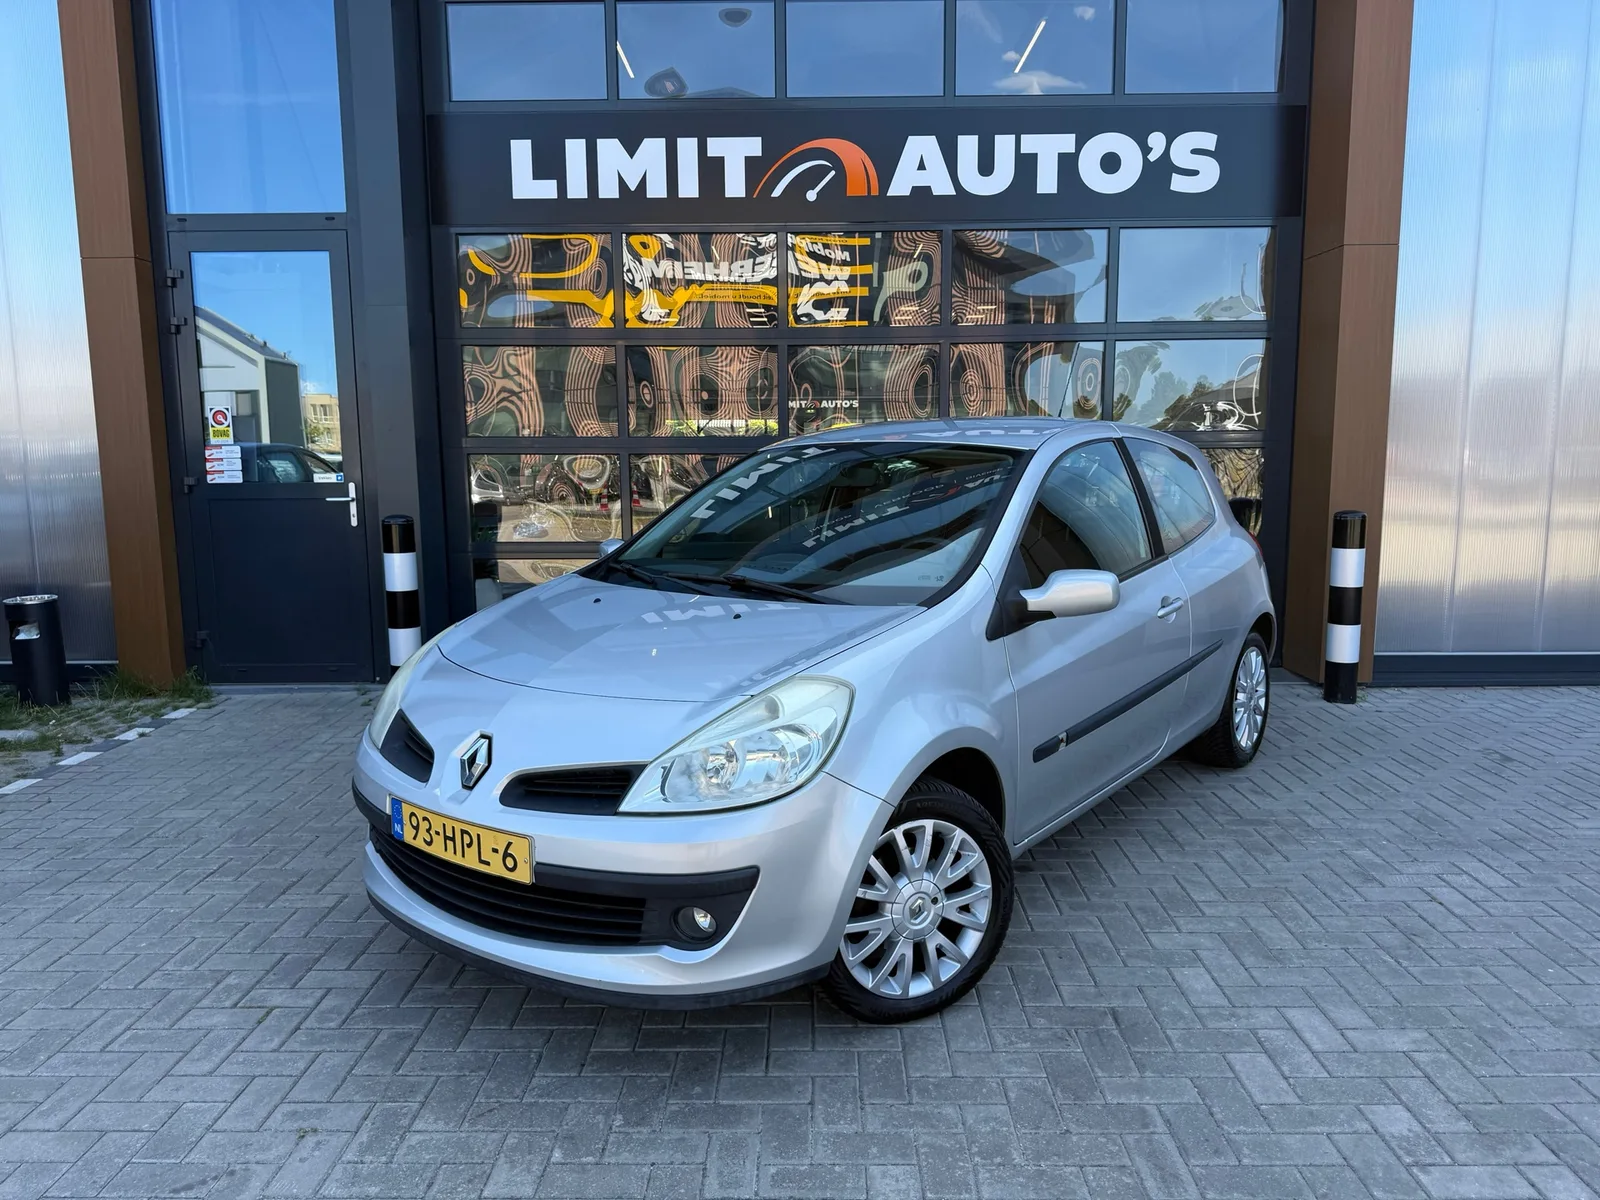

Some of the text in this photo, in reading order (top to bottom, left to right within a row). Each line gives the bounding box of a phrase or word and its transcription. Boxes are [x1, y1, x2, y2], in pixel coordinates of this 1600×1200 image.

[510, 132, 1220, 199] LIMIT AUTO'S
[788, 400, 859, 408] MIT AUTO'S
[212, 428, 230, 439] BOVAG
[394, 822, 403, 834] NL
[409, 811, 518, 873] 93-HPL-6
